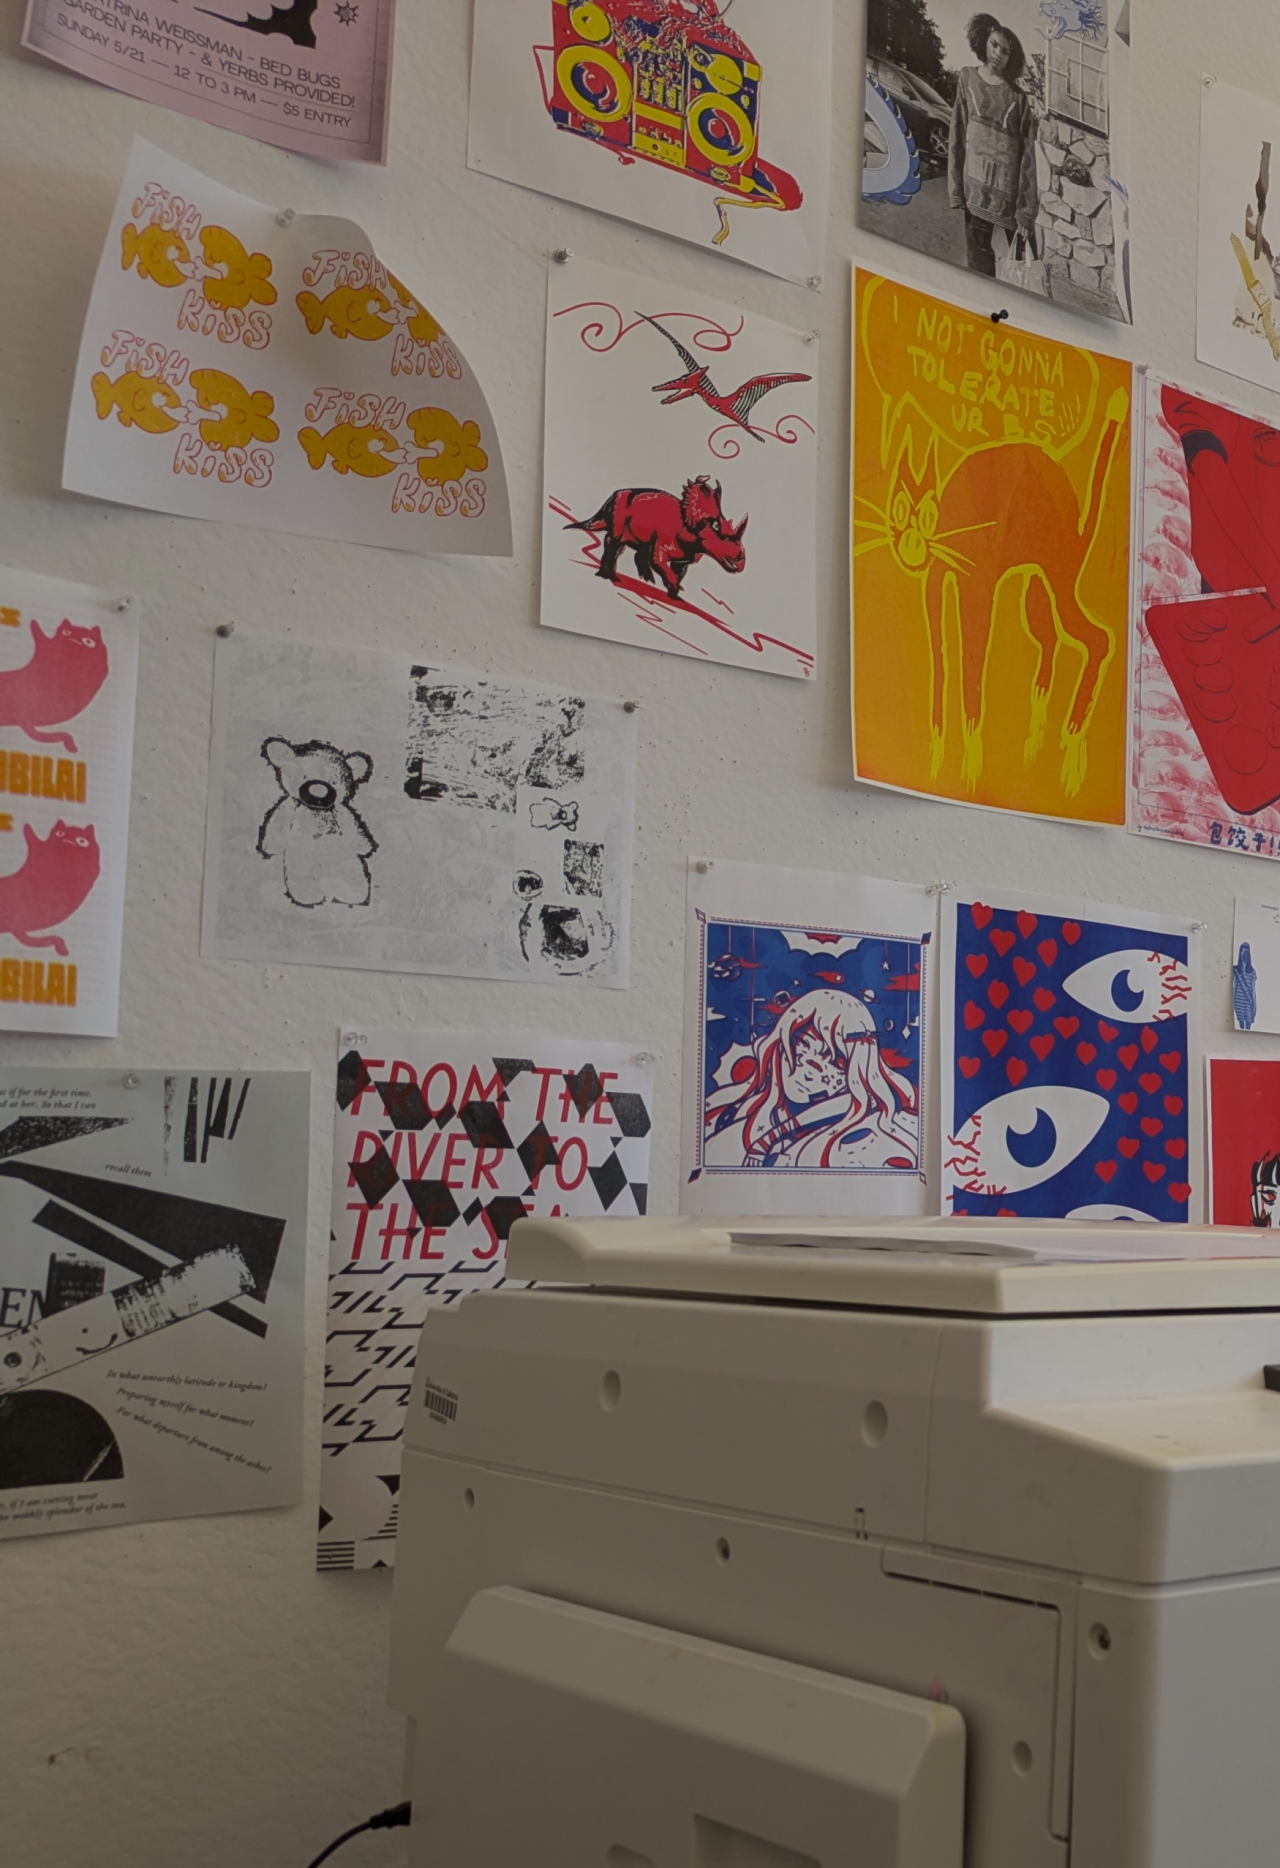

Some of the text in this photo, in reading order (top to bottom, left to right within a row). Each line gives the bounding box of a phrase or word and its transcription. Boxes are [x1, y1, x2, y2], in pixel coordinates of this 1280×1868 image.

[56, 12, 353, 128] SUNDAY 5/21 12 TO 3 PM $5 ENTRY
[63, 0, 356, 108] GARDEN PARTY & YERBS PROVIDED!
[155, 17, 341, 89] WEISSMAN BED BUGS
[893, 295, 1064, 387] I NOT GONNA
[907, 345, 1055, 417] TOLERATE
[952, 403, 990, 437] UR
[0, 750, 87, 804] BILAI
[18, 1087, 32, 1099] for
[34, 1087, 48, 1097] the
[49, 1087, 69, 1099] first
[70, 1088, 92, 1098] time.
[20, 1100, 38, 1109] her.
[41, 1100, 52, 1109] So
[53, 1100, 72, 1109] that
[346, 1058, 619, 1126] FROM THE
[105, 1162, 153, 1178] recall them
[346, 1129, 589, 1192] RIVER TO
[346, 1201, 448, 1261] THE
[107, 1369, 117, 1379] In
[119, 1370, 140, 1381] what
[141, 1372, 182, 1386] unearthly
[184, 1375, 217, 1388] latitude
[228, 1380, 268, 1393] kingdom?
[116, 1386, 255, 1428] Preparing myself for what moment?
[116, 1405, 132, 1416] For
[133, 1411, 152, 1426] what
[153, 1420, 190, 1443] departure
[189, 1431, 208, 1449] from
[208, 1442, 235, 1461] among
[234, 1451, 248, 1465] the
